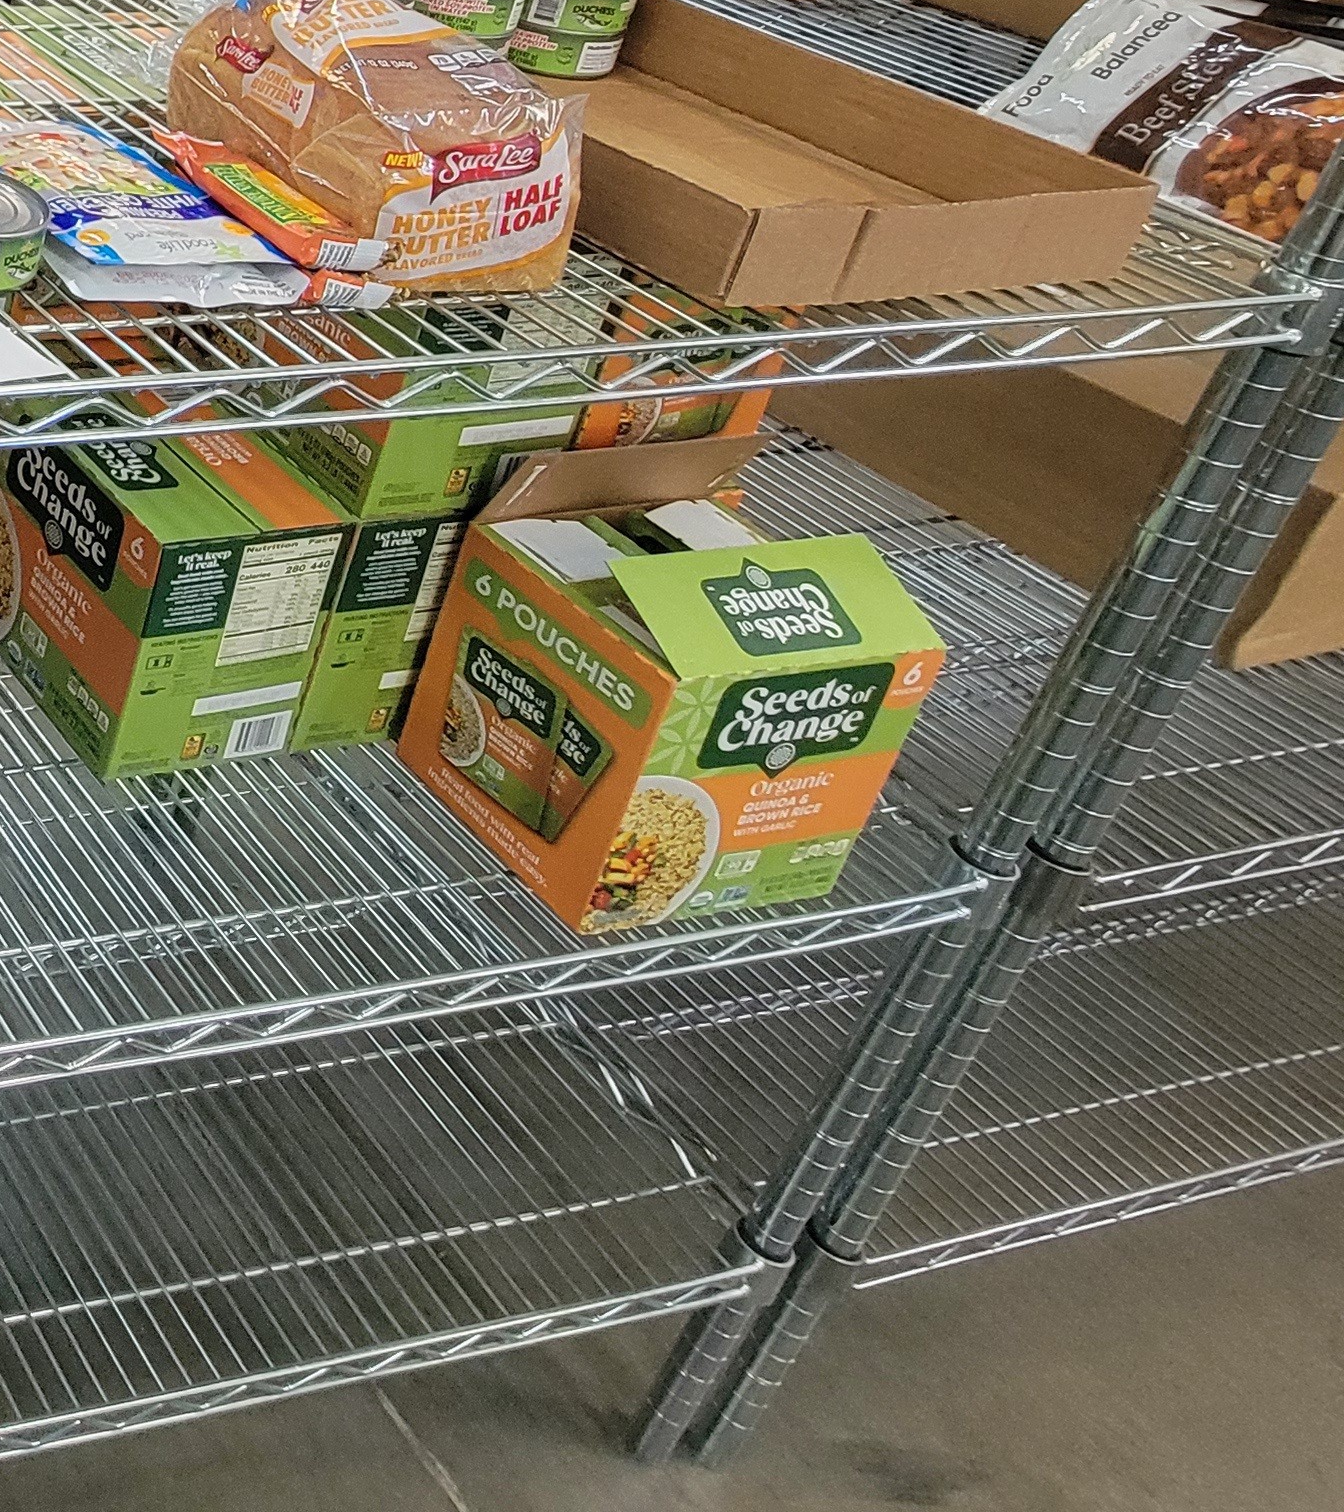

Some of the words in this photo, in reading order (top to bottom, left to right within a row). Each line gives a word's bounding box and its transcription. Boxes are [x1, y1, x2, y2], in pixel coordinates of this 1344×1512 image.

[572, 4, 616, 18] DUCHESS
[1091, 9, 1183, 81] Balanced
[1002, 72, 1055, 118] Food
[1115, 90, 1179, 146] Beef
[384, 152, 425, 169] NEW!
[503, 175, 564, 209] HALF
[392, 196, 493, 234] HONEY
[498, 203, 562, 236] LOAF
[16, 455, 107, 567] Change
[131, 536, 144, 561] 6
[246, 541, 299, 554] Nutrition
[308, 536, 340, 546] Facts
[374, 529, 402, 541] Let's
[402, 527, 427, 538] keep
[177, 553, 205, 565] Let's
[206, 549, 232, 562] keep
[239, 570, 271, 582] Calories
[285, 564, 307, 574] 280
[309, 559, 331, 571] 440
[36, 547, 93, 615] Organic
[718, 582, 829, 616] Change
[737, 620, 754, 637] of
[761, 607, 844, 645] Seeds
[475, 574, 493, 596] 6
[496, 588, 635, 712] POUCHES
[477, 646, 535, 701] Seeds
[902, 662, 923, 685] 6
[470, 660, 545, 726] Change
[735, 678, 851, 724] Seeds
[851, 685, 876, 704] of
[717, 707, 865, 753] Change
[750, 771, 835, 799] Organic
[736, 807, 792, 826] BROWN
[794, 803, 823, 818] RICE
[743, 795, 795, 813] QUINOA
[798, 794, 809, 805] &
[732, 824, 759, 837] WITH
[761, 819, 797, 833] GARLIC
